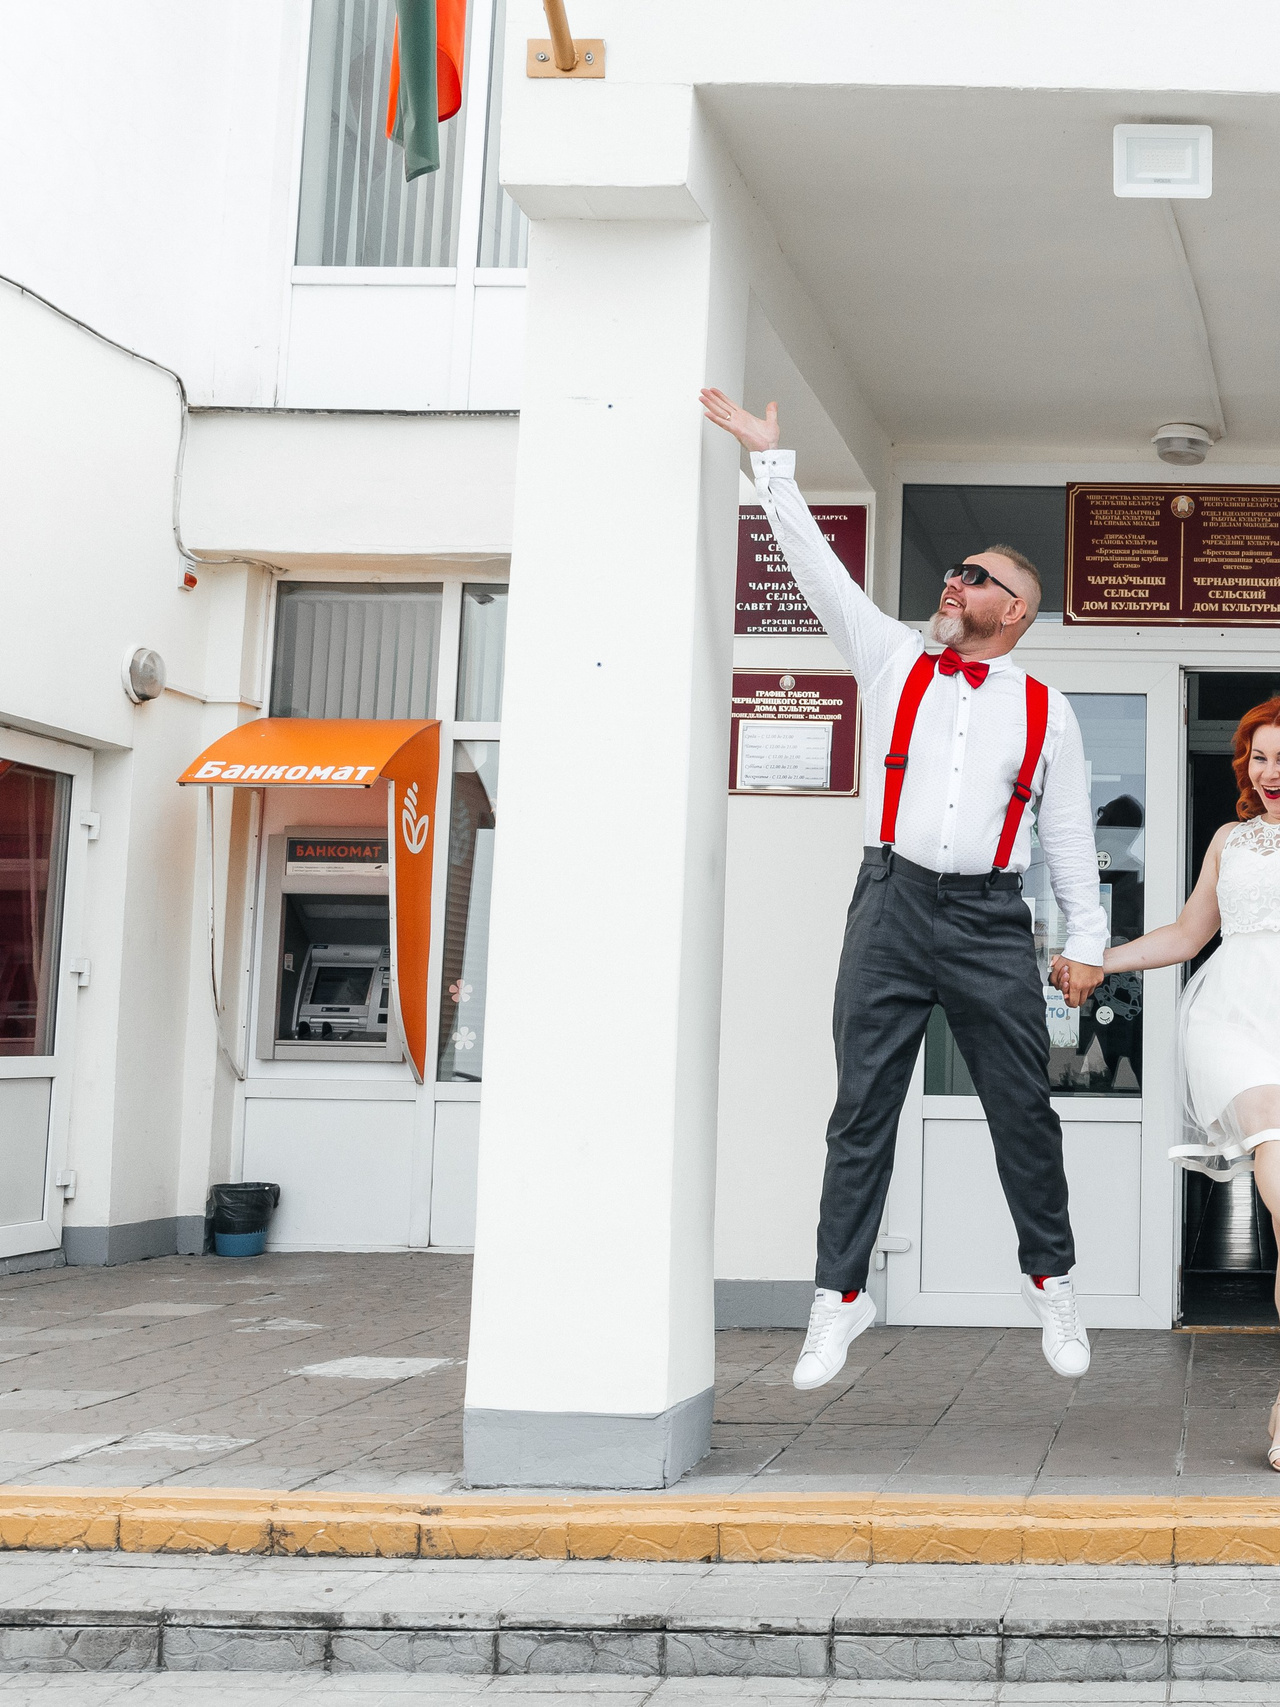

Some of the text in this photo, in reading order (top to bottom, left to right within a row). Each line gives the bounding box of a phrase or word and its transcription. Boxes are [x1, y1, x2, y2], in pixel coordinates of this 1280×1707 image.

[1087, 575, 1166, 586] ЧАРНАЎЧЫЦКІ
[1193, 577, 1280, 587] ЧЕРНАВЧИЦКИЙ
[1104, 589, 1149, 597] СЕЛЬСКІ
[1208, 590, 1266, 599] СЕЛЬСКИЙ
[736, 603, 772, 611] САВЕТ
[1082, 601, 1170, 611] ДОМ КУЛЬТУРЫ
[1193, 603, 1280, 612] ДОМ КУЛЬТУРЫ
[193, 761, 376, 781] Банкомат
[296, 845, 382, 858] БАНКОМАТ
